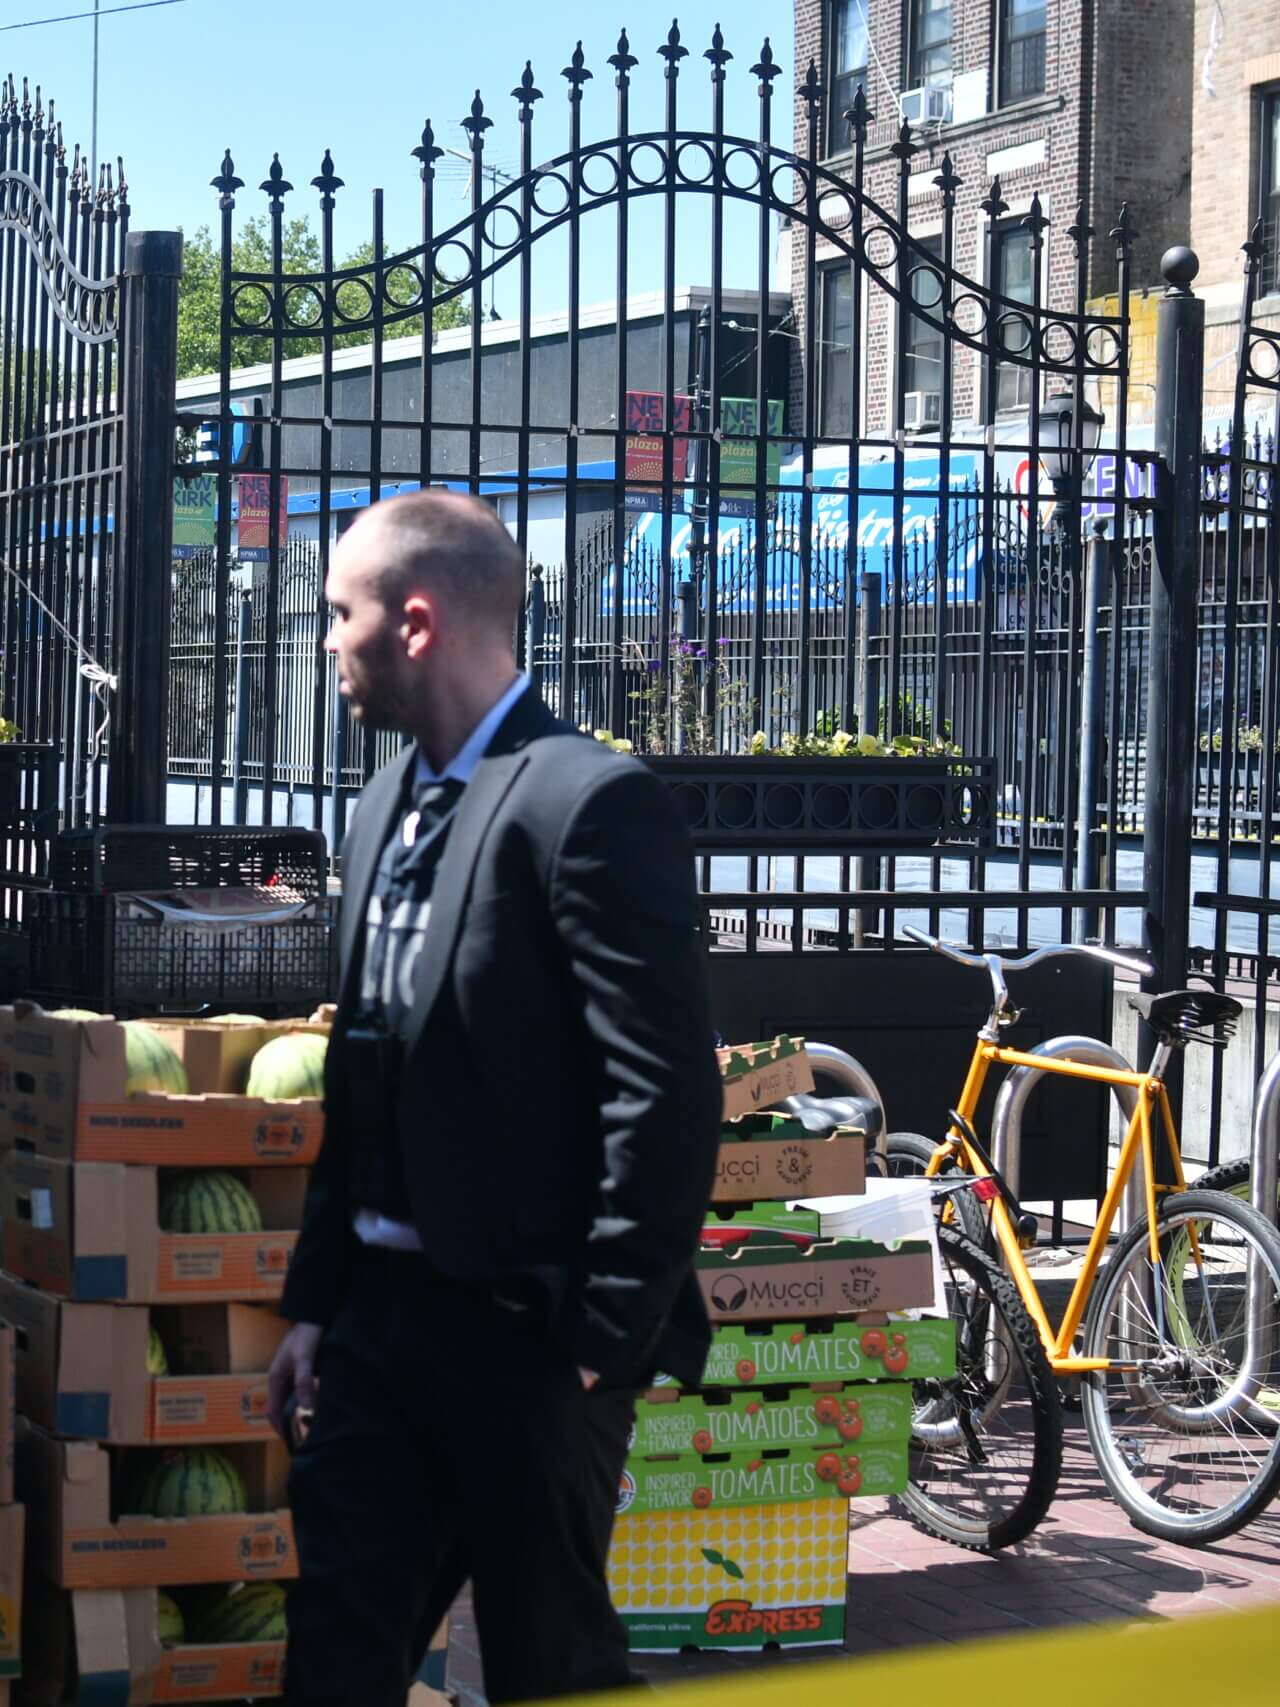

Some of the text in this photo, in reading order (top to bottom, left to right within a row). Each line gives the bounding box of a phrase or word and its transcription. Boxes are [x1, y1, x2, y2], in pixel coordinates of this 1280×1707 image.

[626, 437, 659, 452] plaza
[721, 444, 754, 457] plaza
[716, 1154, 760, 1177] ucci
[788, 1158, 799, 1173] &
[750, 1277, 824, 1300] Mucci
[852, 1279, 869, 1293] ET
[751, 1337, 861, 1373] TOMATES
[645, 1414, 696, 1432] INSPIRED
[705, 1406, 818, 1442] TOMATOES
[645, 1472, 696, 1489] INSPIRED
[709, 1462, 816, 1499] TOMATES
[704, 1599, 825, 1635] EXPRESS
